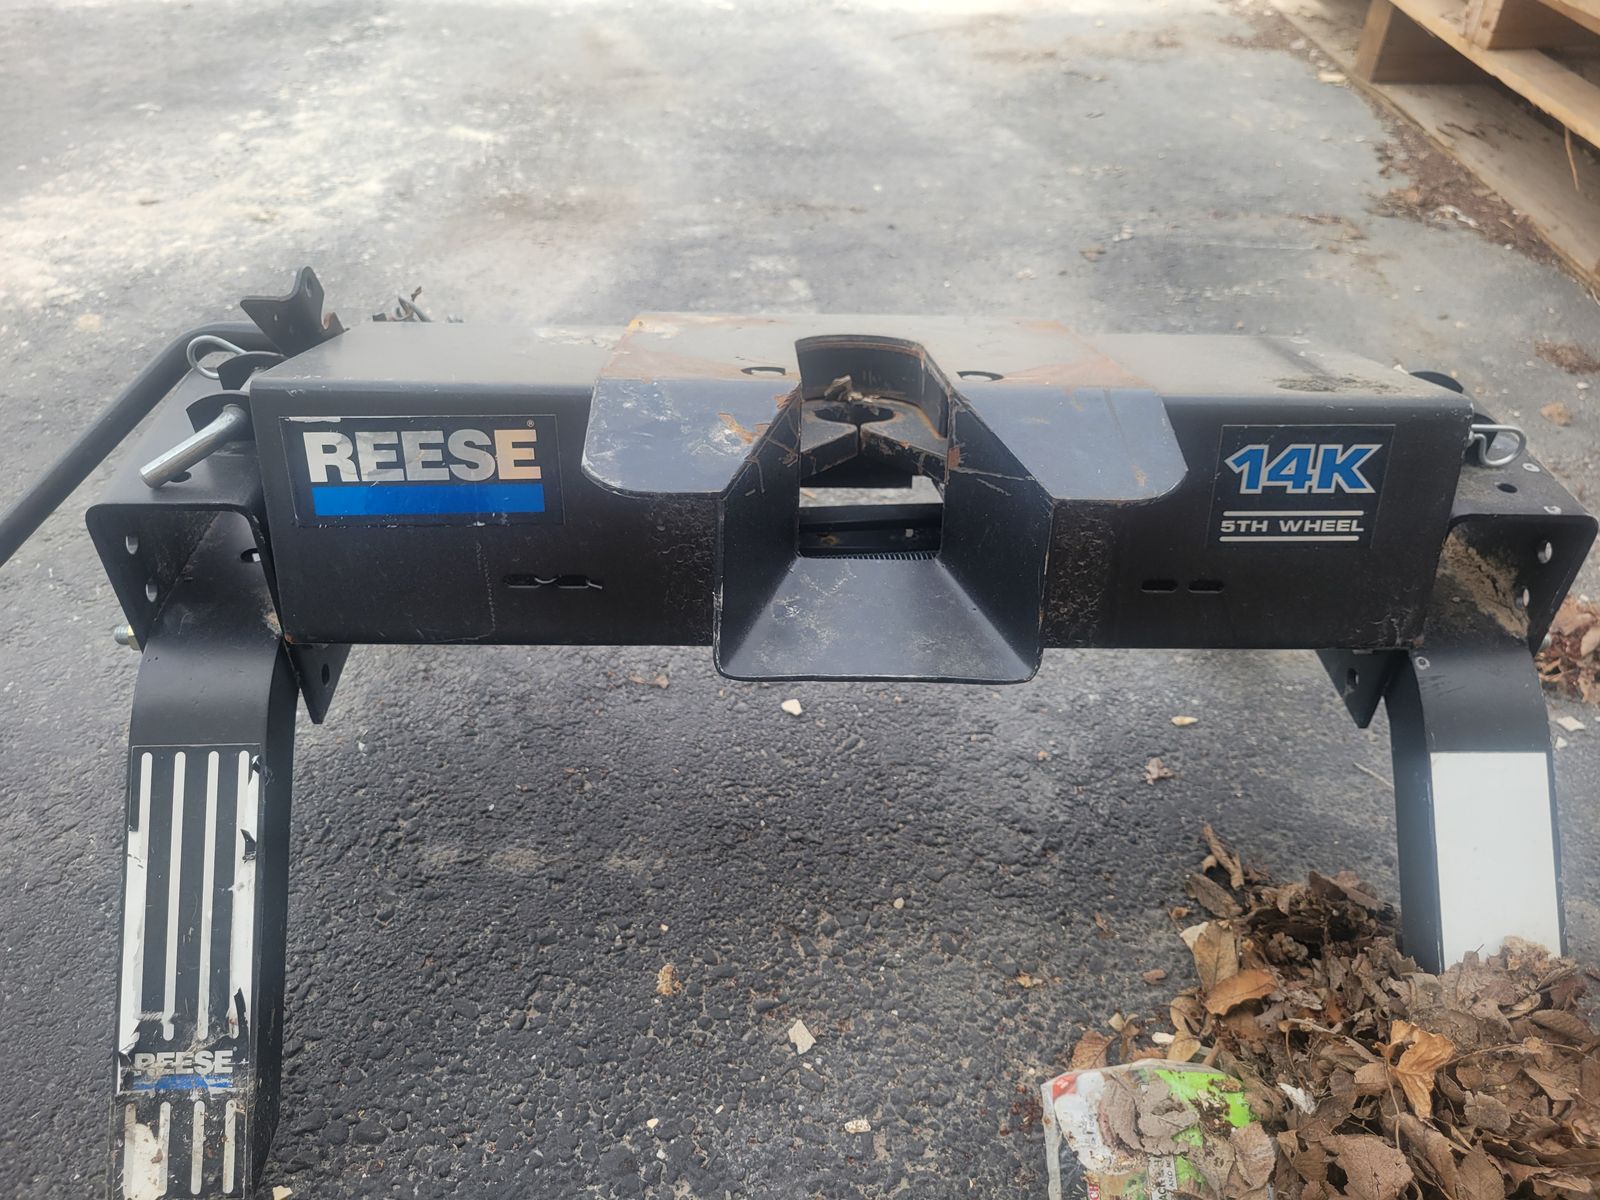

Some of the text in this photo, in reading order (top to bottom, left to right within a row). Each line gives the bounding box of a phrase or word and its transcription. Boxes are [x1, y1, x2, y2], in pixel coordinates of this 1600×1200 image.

[303, 429, 541, 482] REESE
[1224, 444, 1382, 494] 14K
[1220, 519, 1364, 532] 5TH WHEEL
[134, 1050, 233, 1075] REESE
